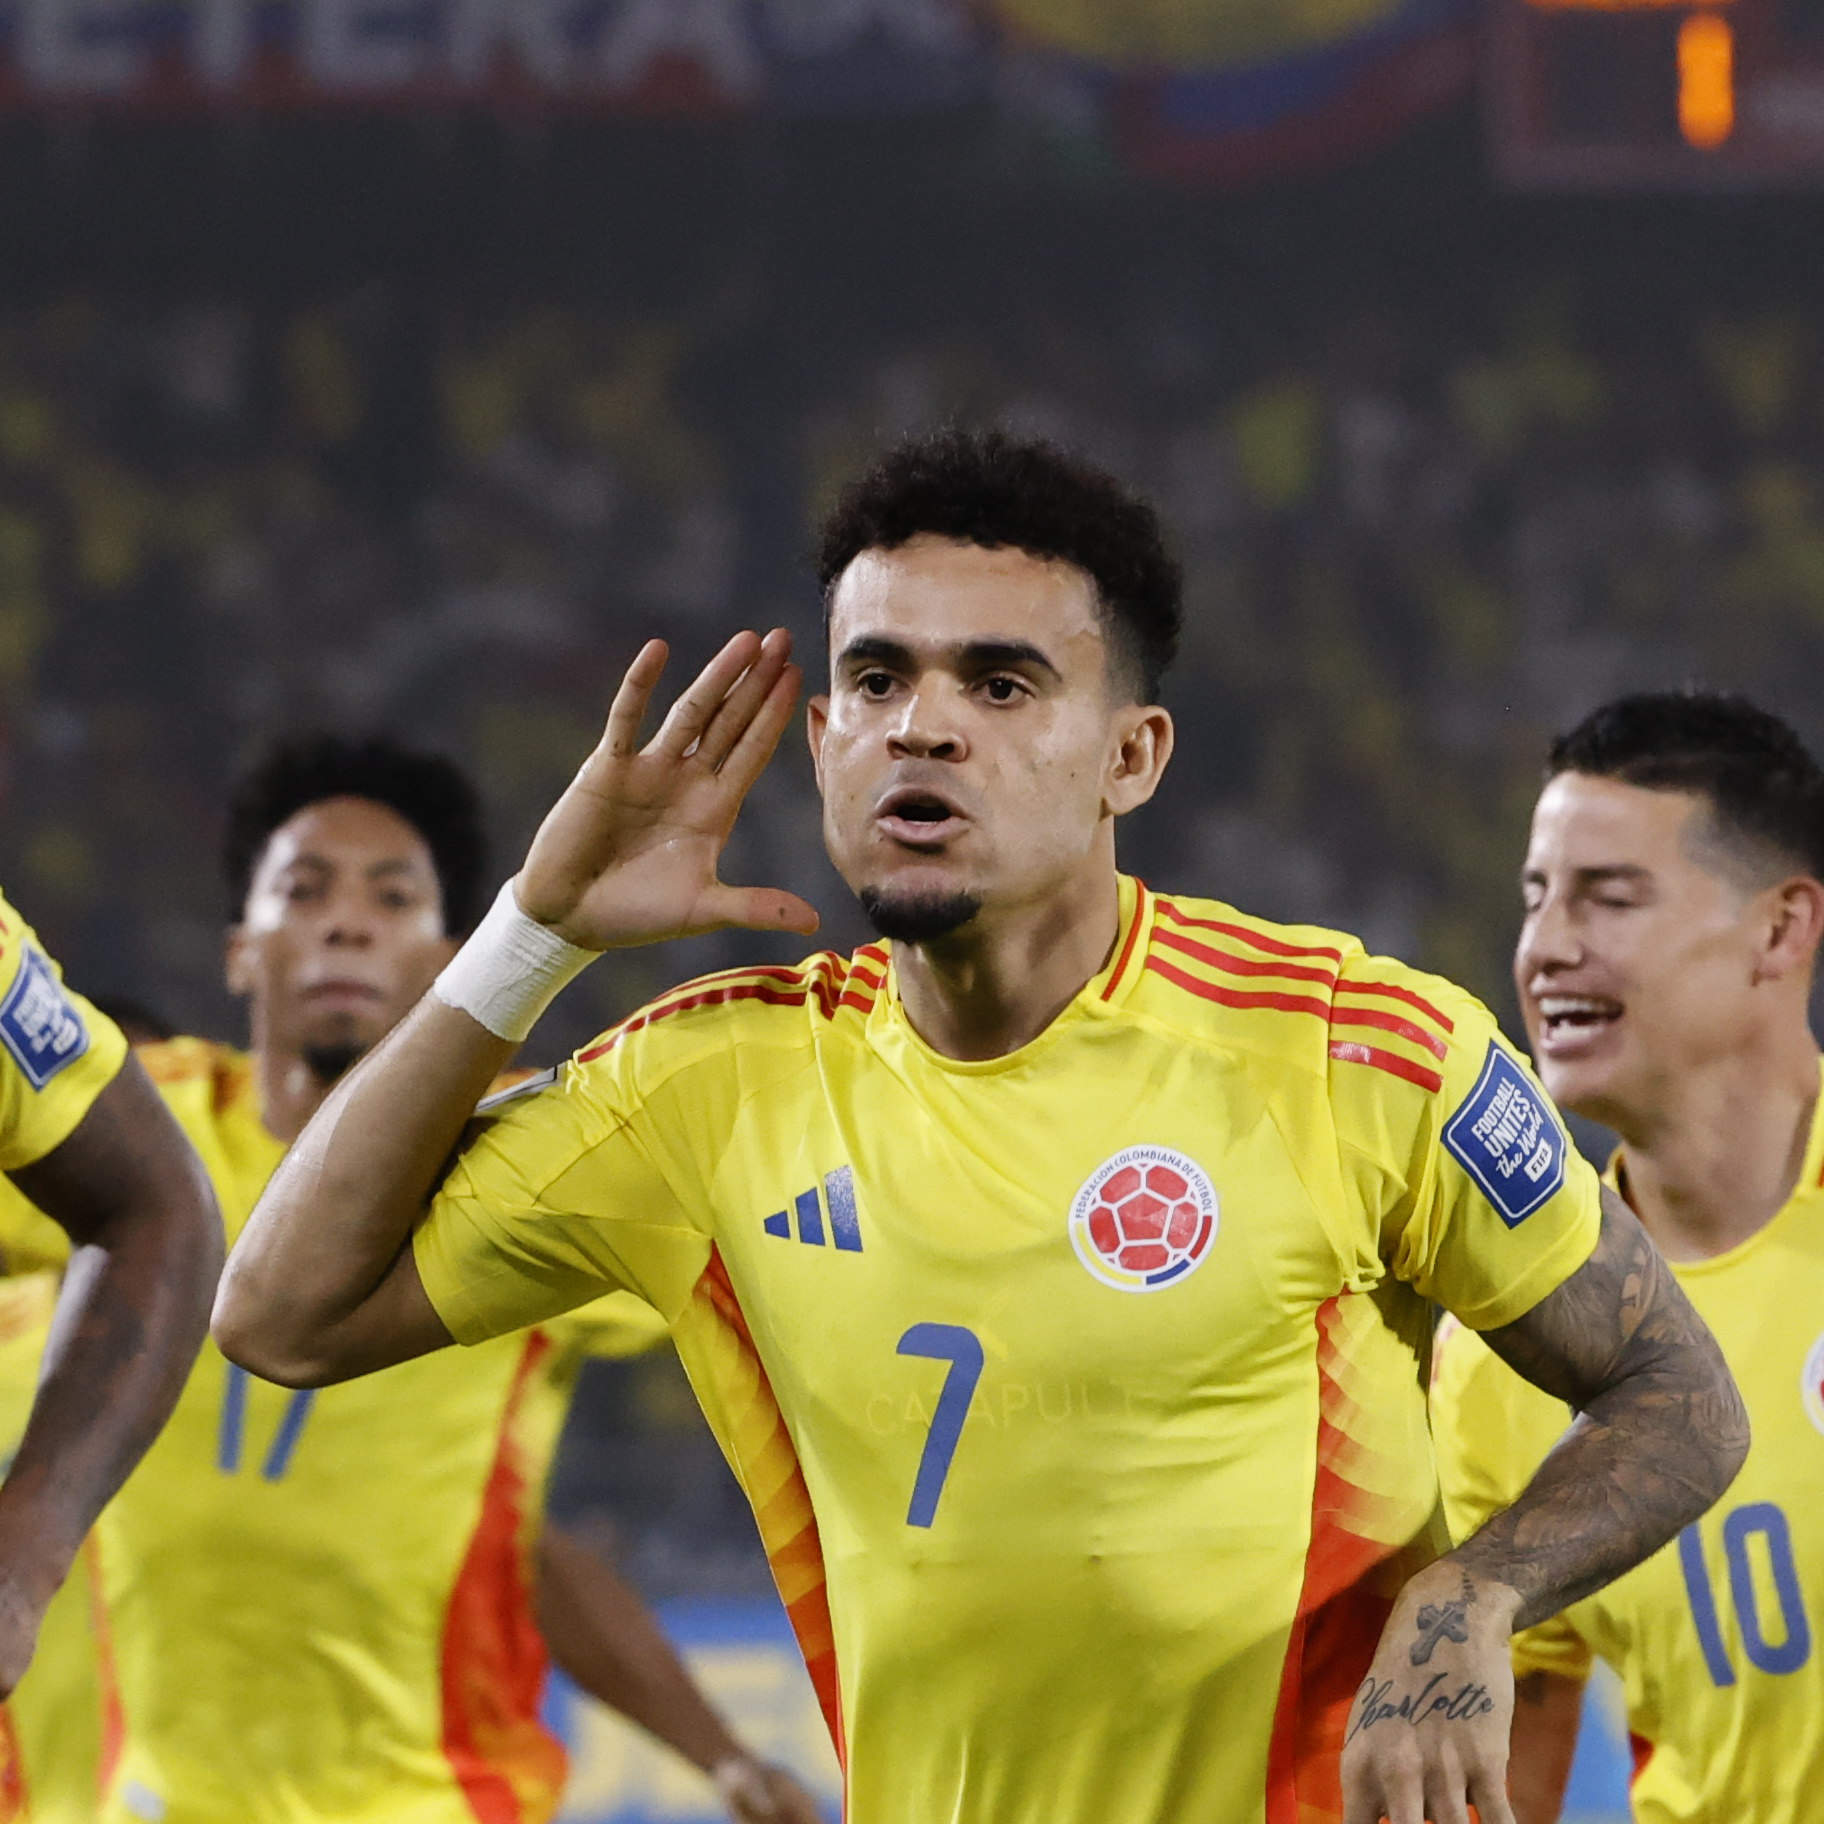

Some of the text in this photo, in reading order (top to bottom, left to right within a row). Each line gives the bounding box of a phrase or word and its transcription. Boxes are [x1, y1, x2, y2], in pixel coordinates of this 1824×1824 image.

[1471, 1077, 1516, 1142] FOOTBALL
[1483, 1089, 1531, 1158] UNITES
[1114, 1149, 1182, 1169] COLOMBIANA
[1181, 1163, 1195, 1176] DE
[1191, 1174, 1213, 1212] FUTBOL
[1496, 1152, 1523, 1179] the
[1531, 1147, 1550, 1175] FIFA
[896, 1321, 985, 1528] 7
[1678, 1501, 1811, 1687] 10
